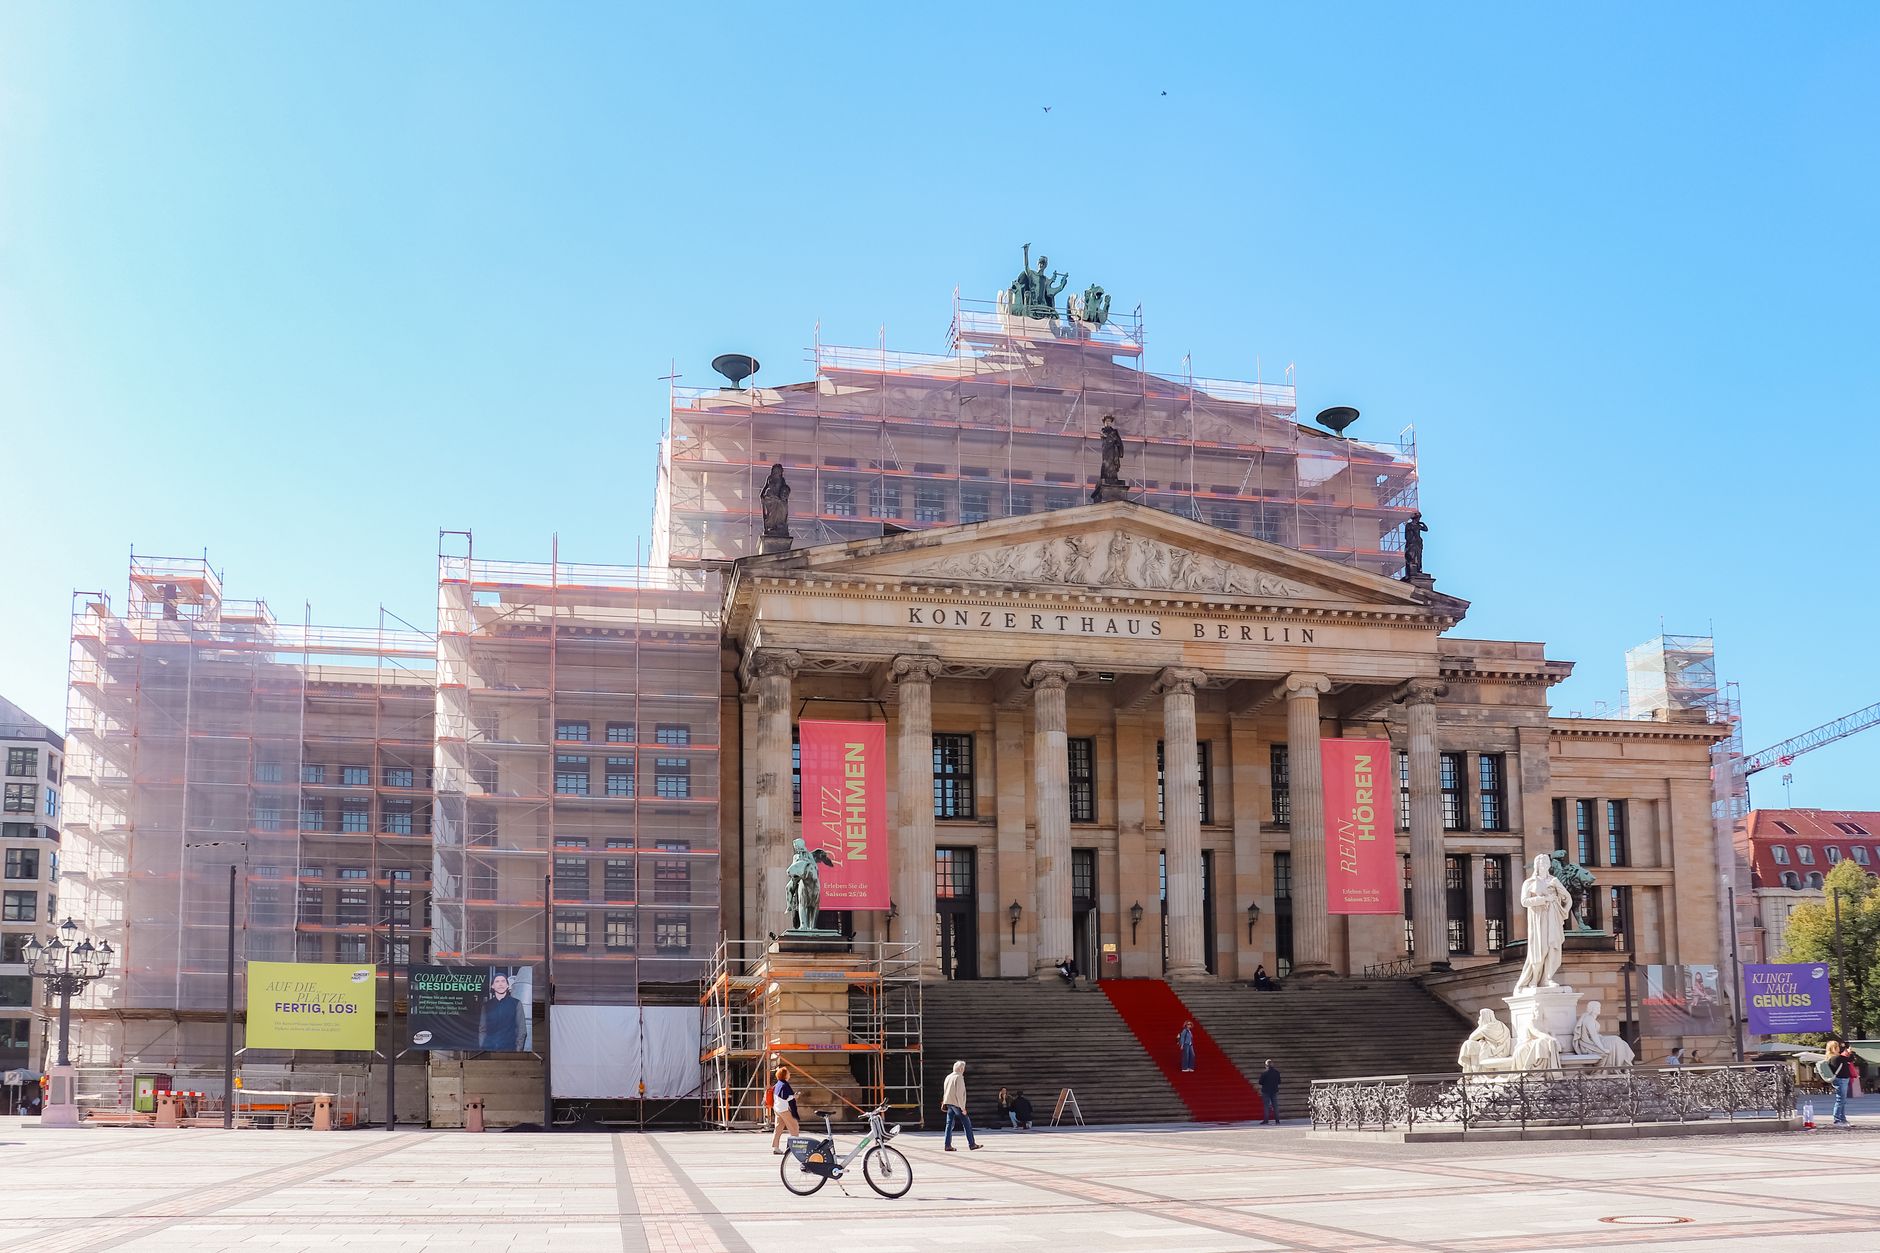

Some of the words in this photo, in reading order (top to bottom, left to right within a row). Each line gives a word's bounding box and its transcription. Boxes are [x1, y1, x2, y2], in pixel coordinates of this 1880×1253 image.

[908, 607, 1162, 636] KONZERTHAUS
[1194, 623, 1314, 643] BERLIN
[845, 743, 868, 860] NEHMEN
[1353, 755, 1376, 841] HÖREN
[1338, 818, 1357, 875] REIN
[823, 882, 847, 890] Erleben
[825, 890, 848, 898] Saison
[414, 972, 472, 983] COMPOSER
[473, 974, 487, 983] IN
[1752, 973, 1792, 984] KLINGT
[266, 981, 292, 993] AUF
[419, 982, 482, 991] RESIDENCE
[1766, 983, 1798, 994] NACH
[1753, 994, 1811, 1007] GENUSS
[275, 1003, 325, 1015] FERTIG,
[328, 1004, 358, 1014] LOS!
